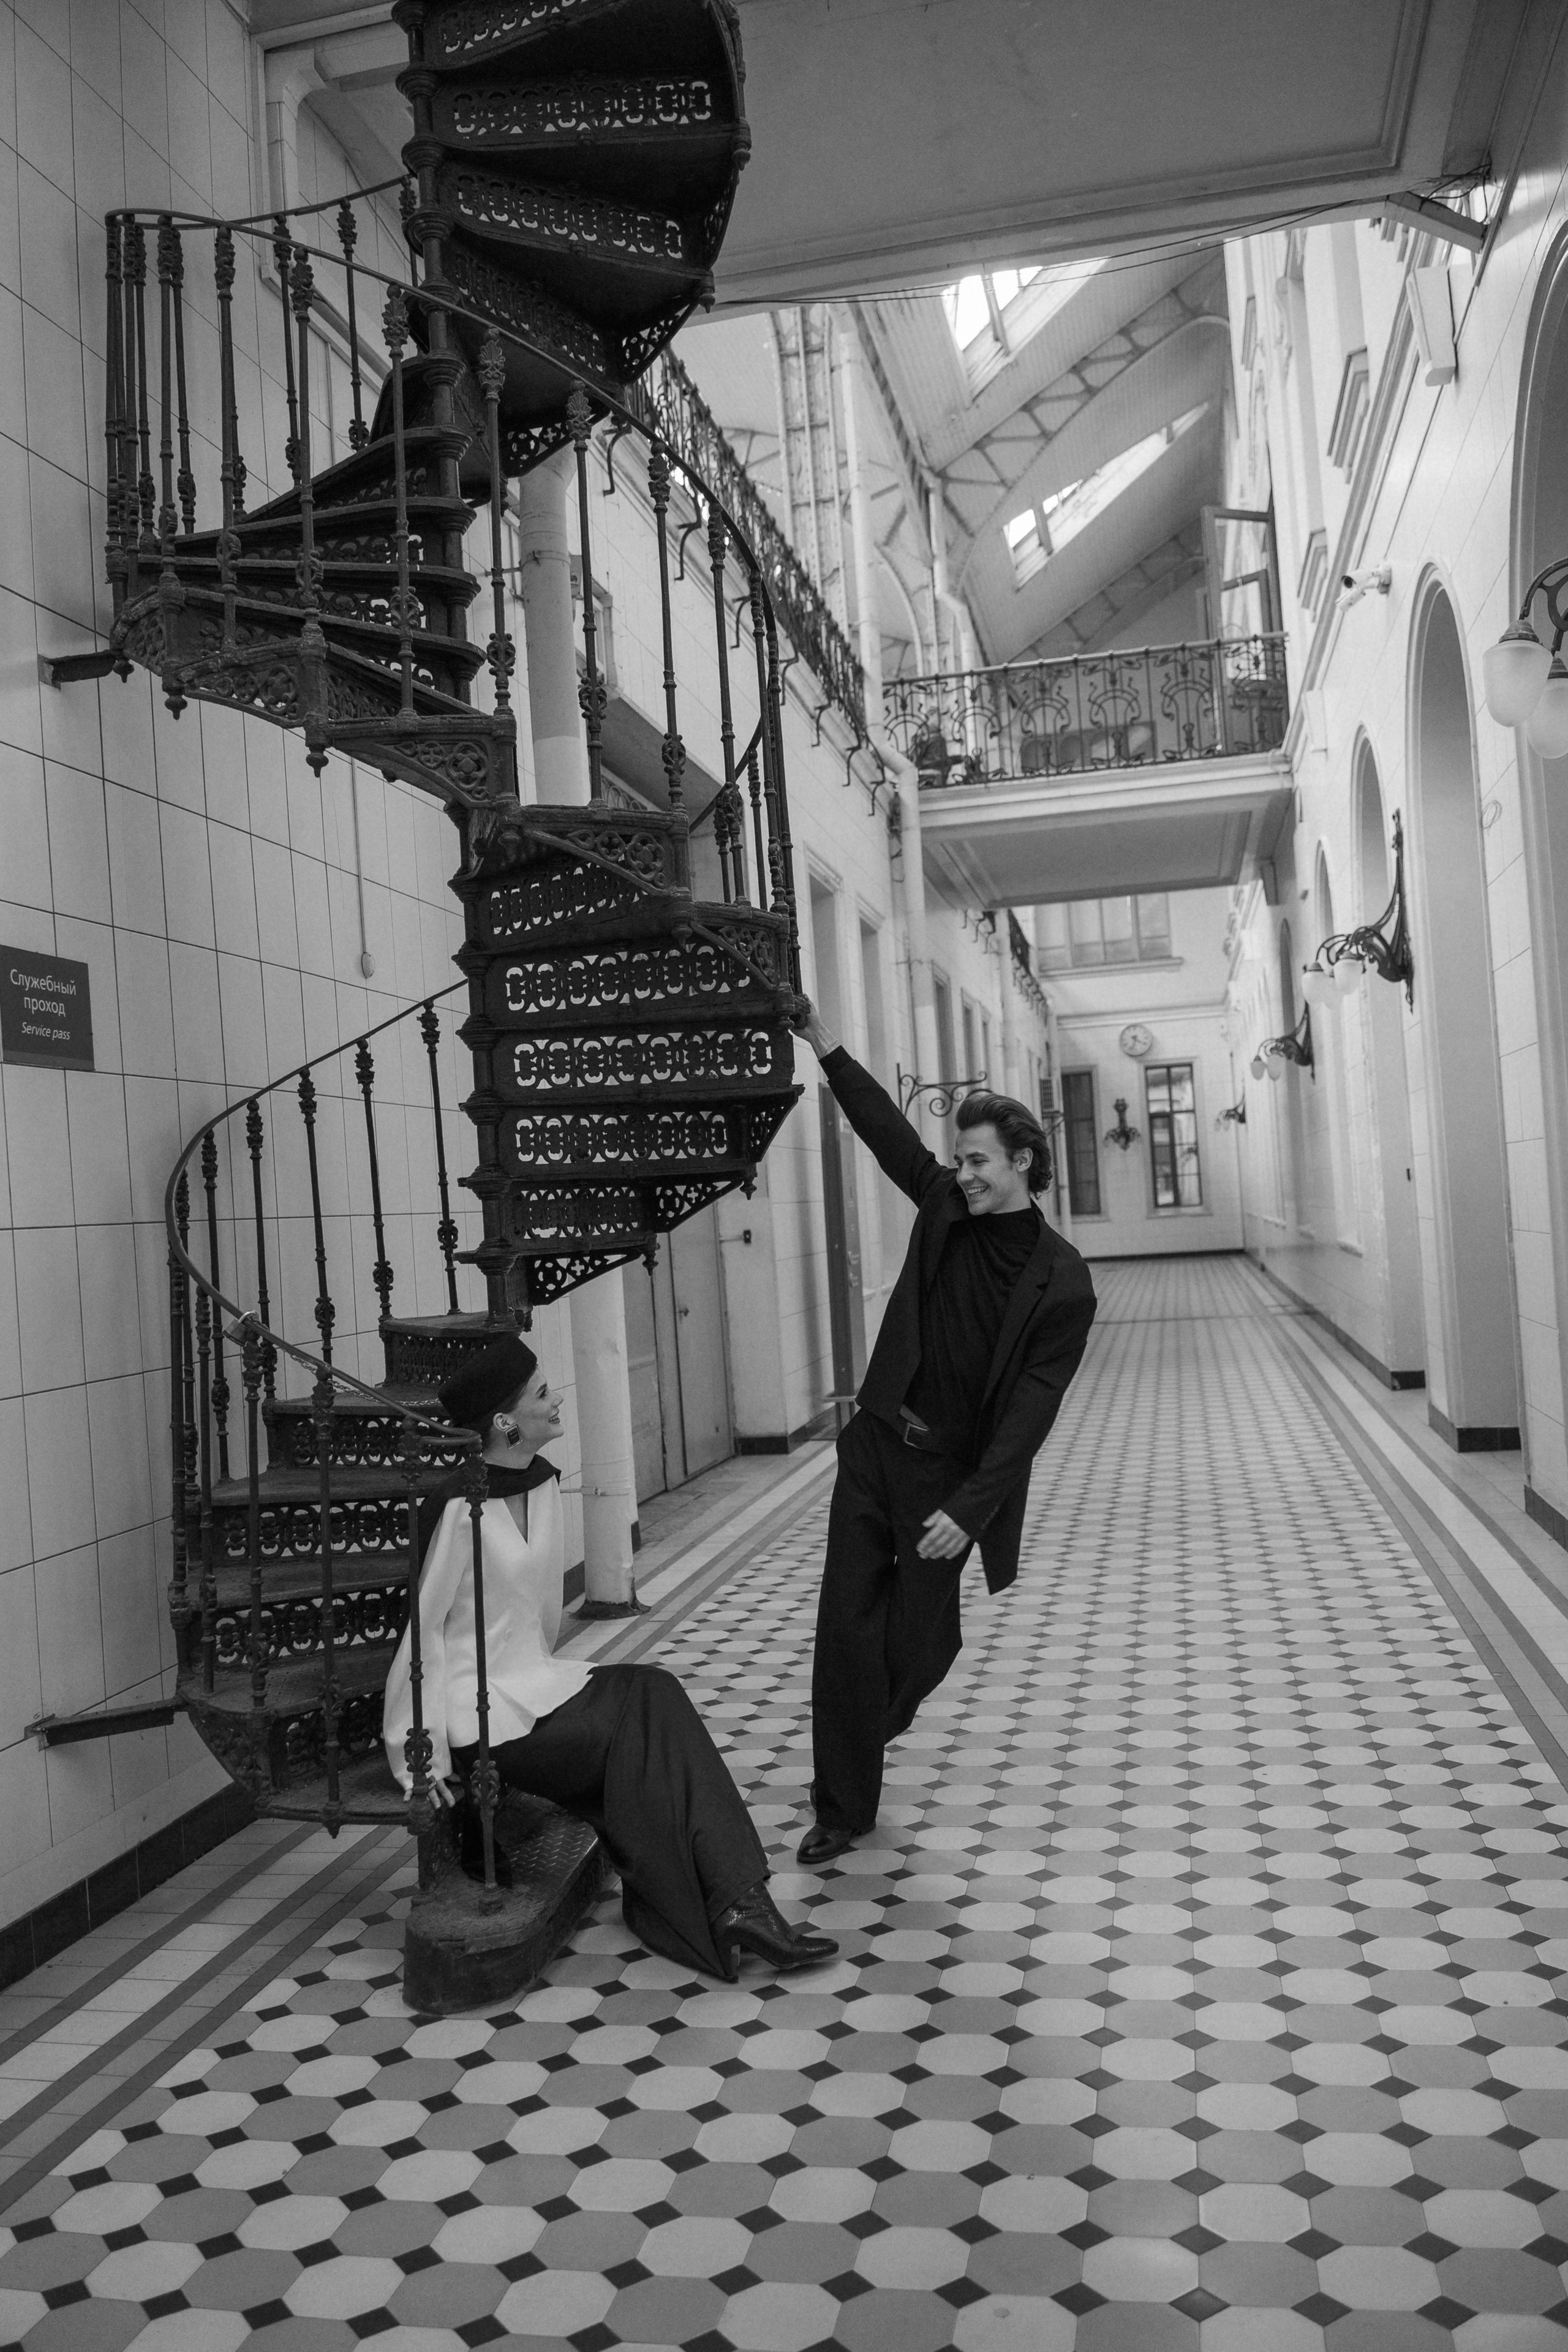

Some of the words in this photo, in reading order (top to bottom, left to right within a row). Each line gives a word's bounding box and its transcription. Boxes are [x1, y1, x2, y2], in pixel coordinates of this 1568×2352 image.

[10, 969, 77, 995] Служебный
[24, 997, 66, 1017] проход
[21, 1022, 51, 1037] Service
[52, 1029, 70, 1041] pass
